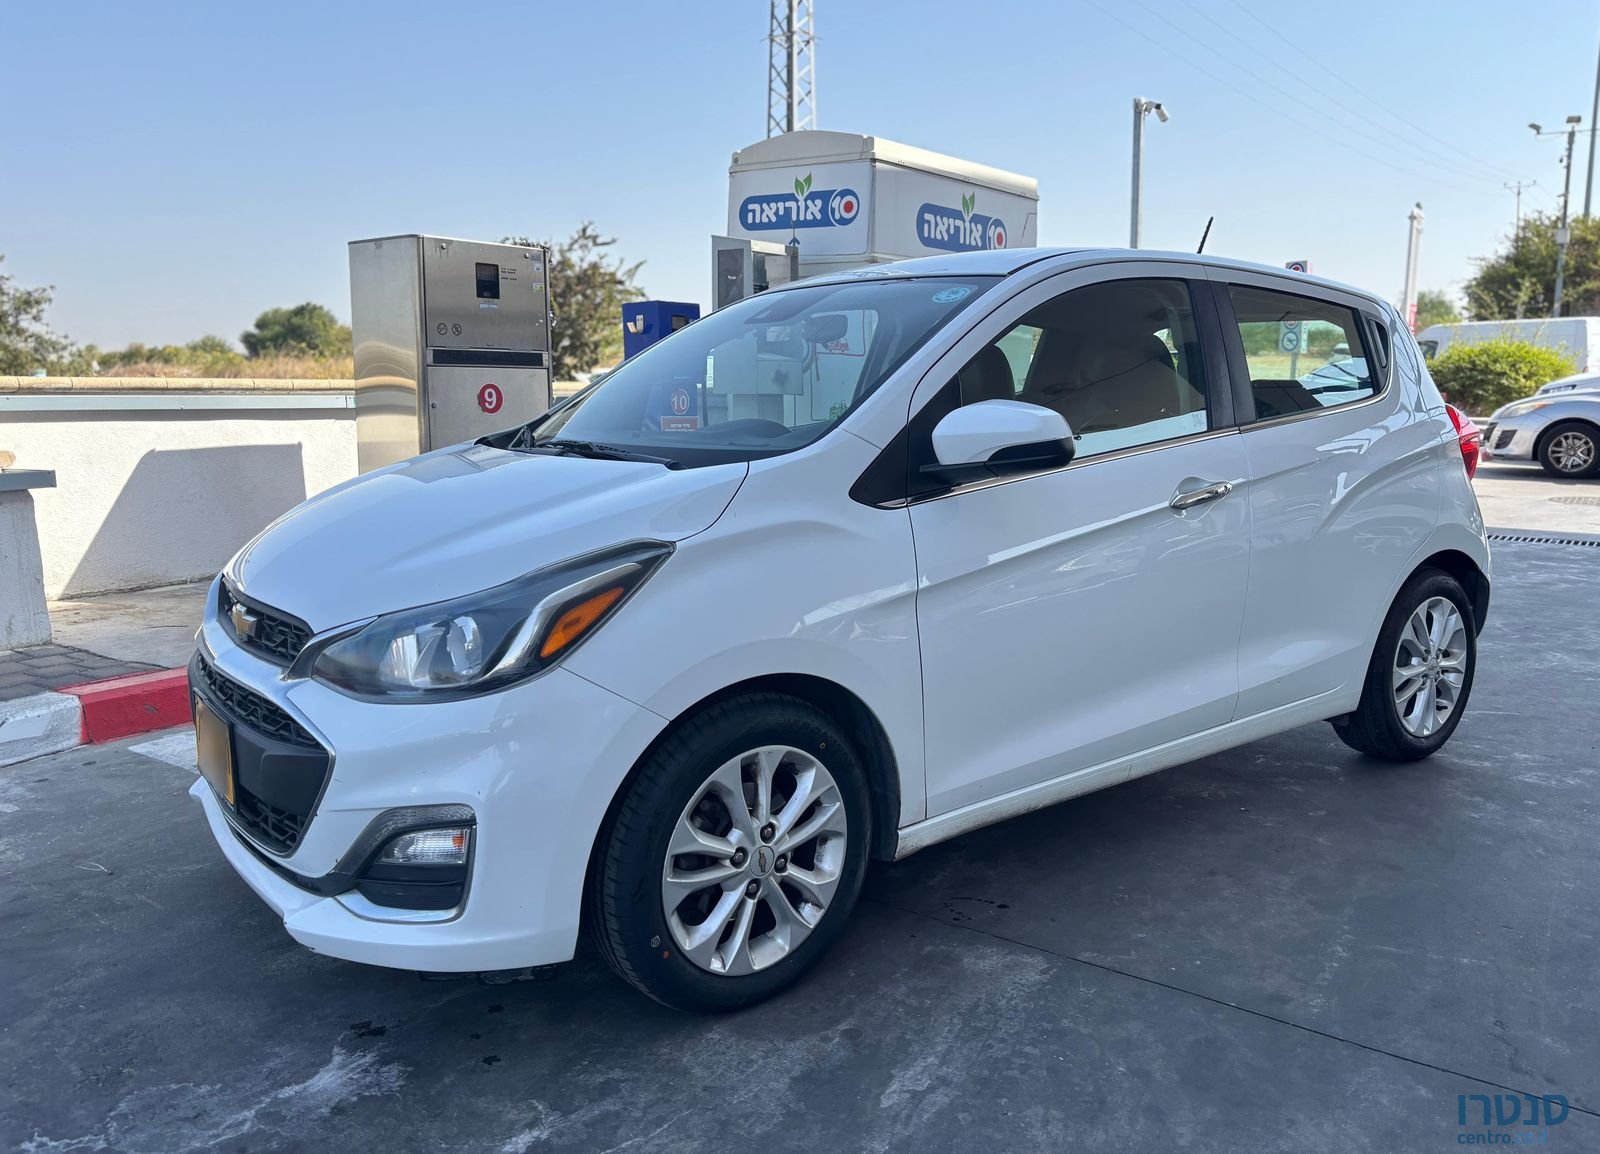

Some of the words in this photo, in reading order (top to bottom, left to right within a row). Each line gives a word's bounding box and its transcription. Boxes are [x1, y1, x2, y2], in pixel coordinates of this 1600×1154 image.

[747, 199, 823, 224] אוריאה
[923, 213, 983, 248] אוריאה
[484, 388, 497, 409] 9
[671, 395, 688, 410] 10
